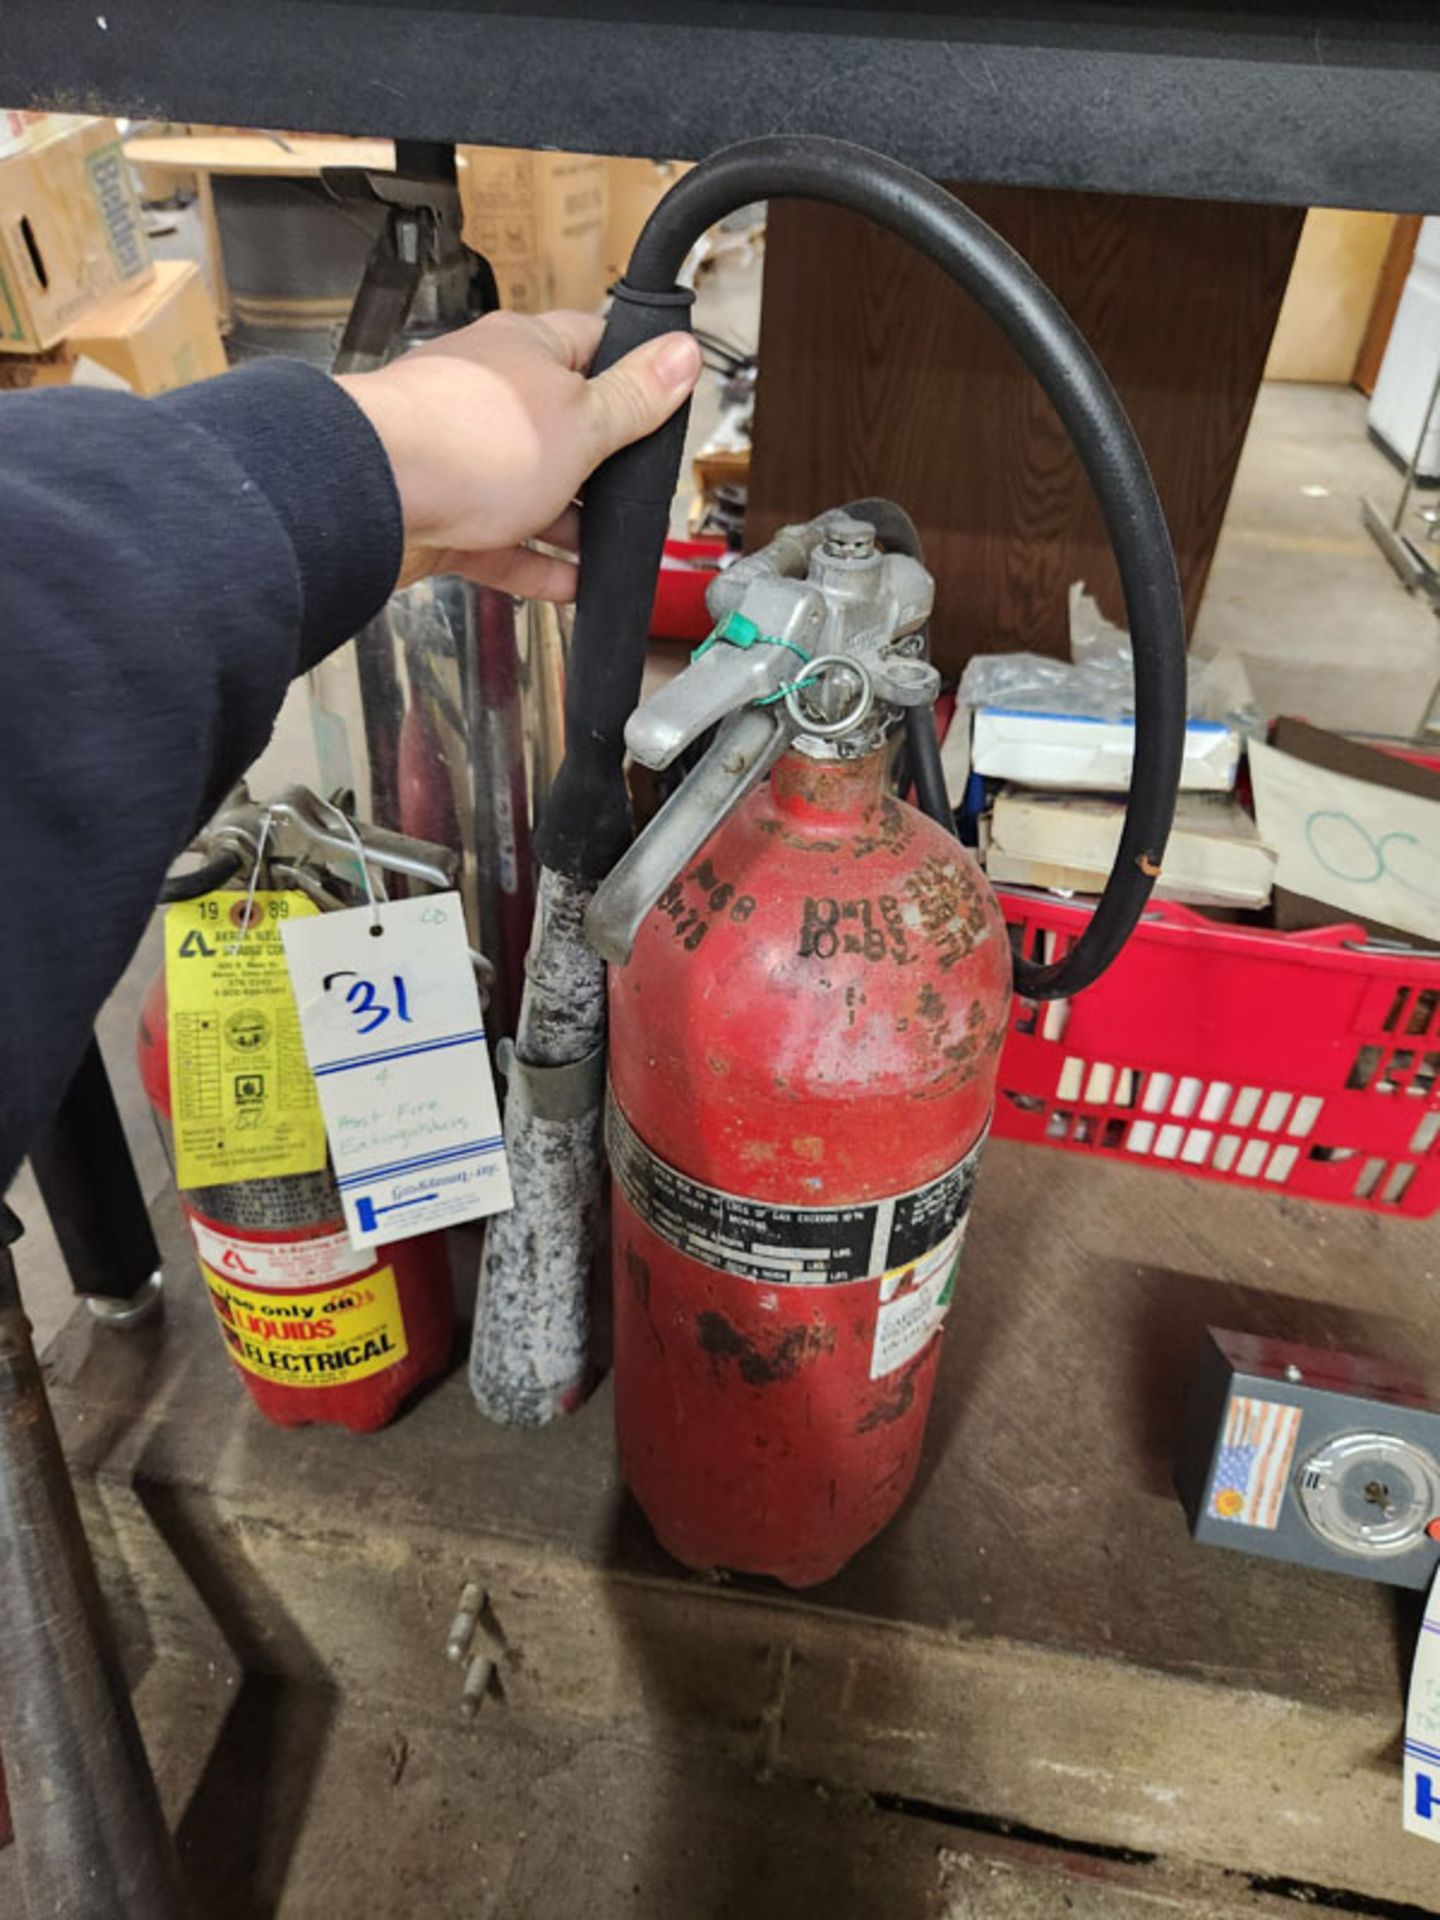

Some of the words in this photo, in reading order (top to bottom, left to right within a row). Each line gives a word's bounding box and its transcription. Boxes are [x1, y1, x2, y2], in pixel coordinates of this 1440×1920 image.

[198, 901, 219, 921] 19
[260, 1299, 316, 1319] only
[233, 1306, 337, 1342] LIQUIDS
[243, 1331, 397, 1373] ELECTRICAL
